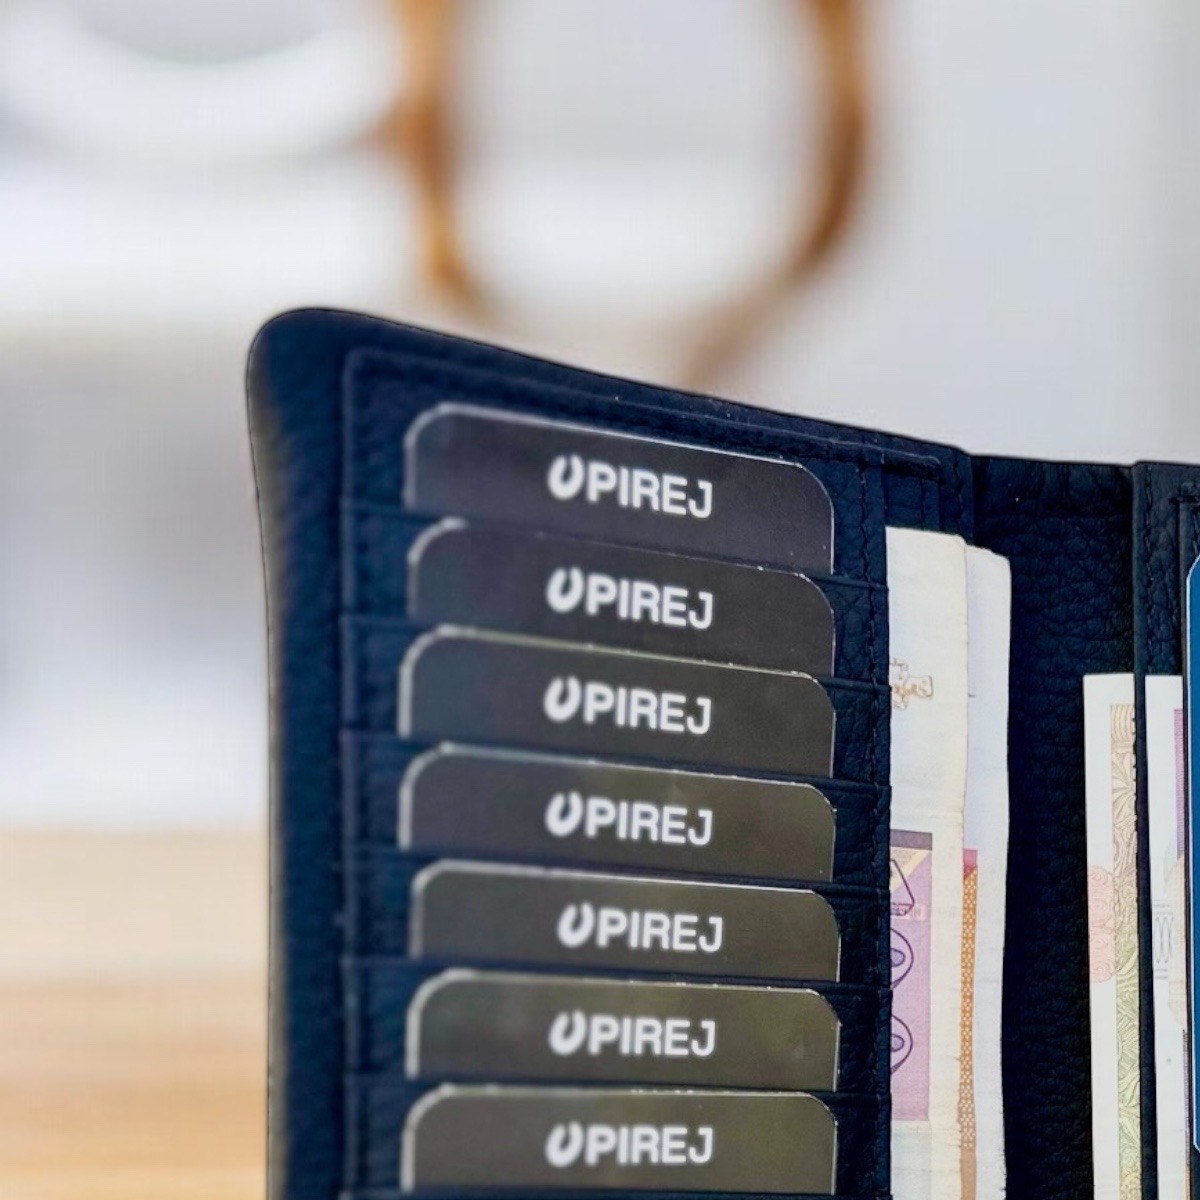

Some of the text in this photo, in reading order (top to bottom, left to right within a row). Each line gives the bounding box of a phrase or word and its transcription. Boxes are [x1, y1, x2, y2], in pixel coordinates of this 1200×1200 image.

[547, 454, 714, 519] UPIREJ
[546, 567, 714, 630] UPIREJ
[543, 676, 712, 735] UPIREJ
[544, 791, 714, 847] UPIREJ
[556, 902, 724, 953] UPIREJ
[548, 1010, 716, 1058] UPIREJ
[545, 1122, 714, 1168] UPIREJ
